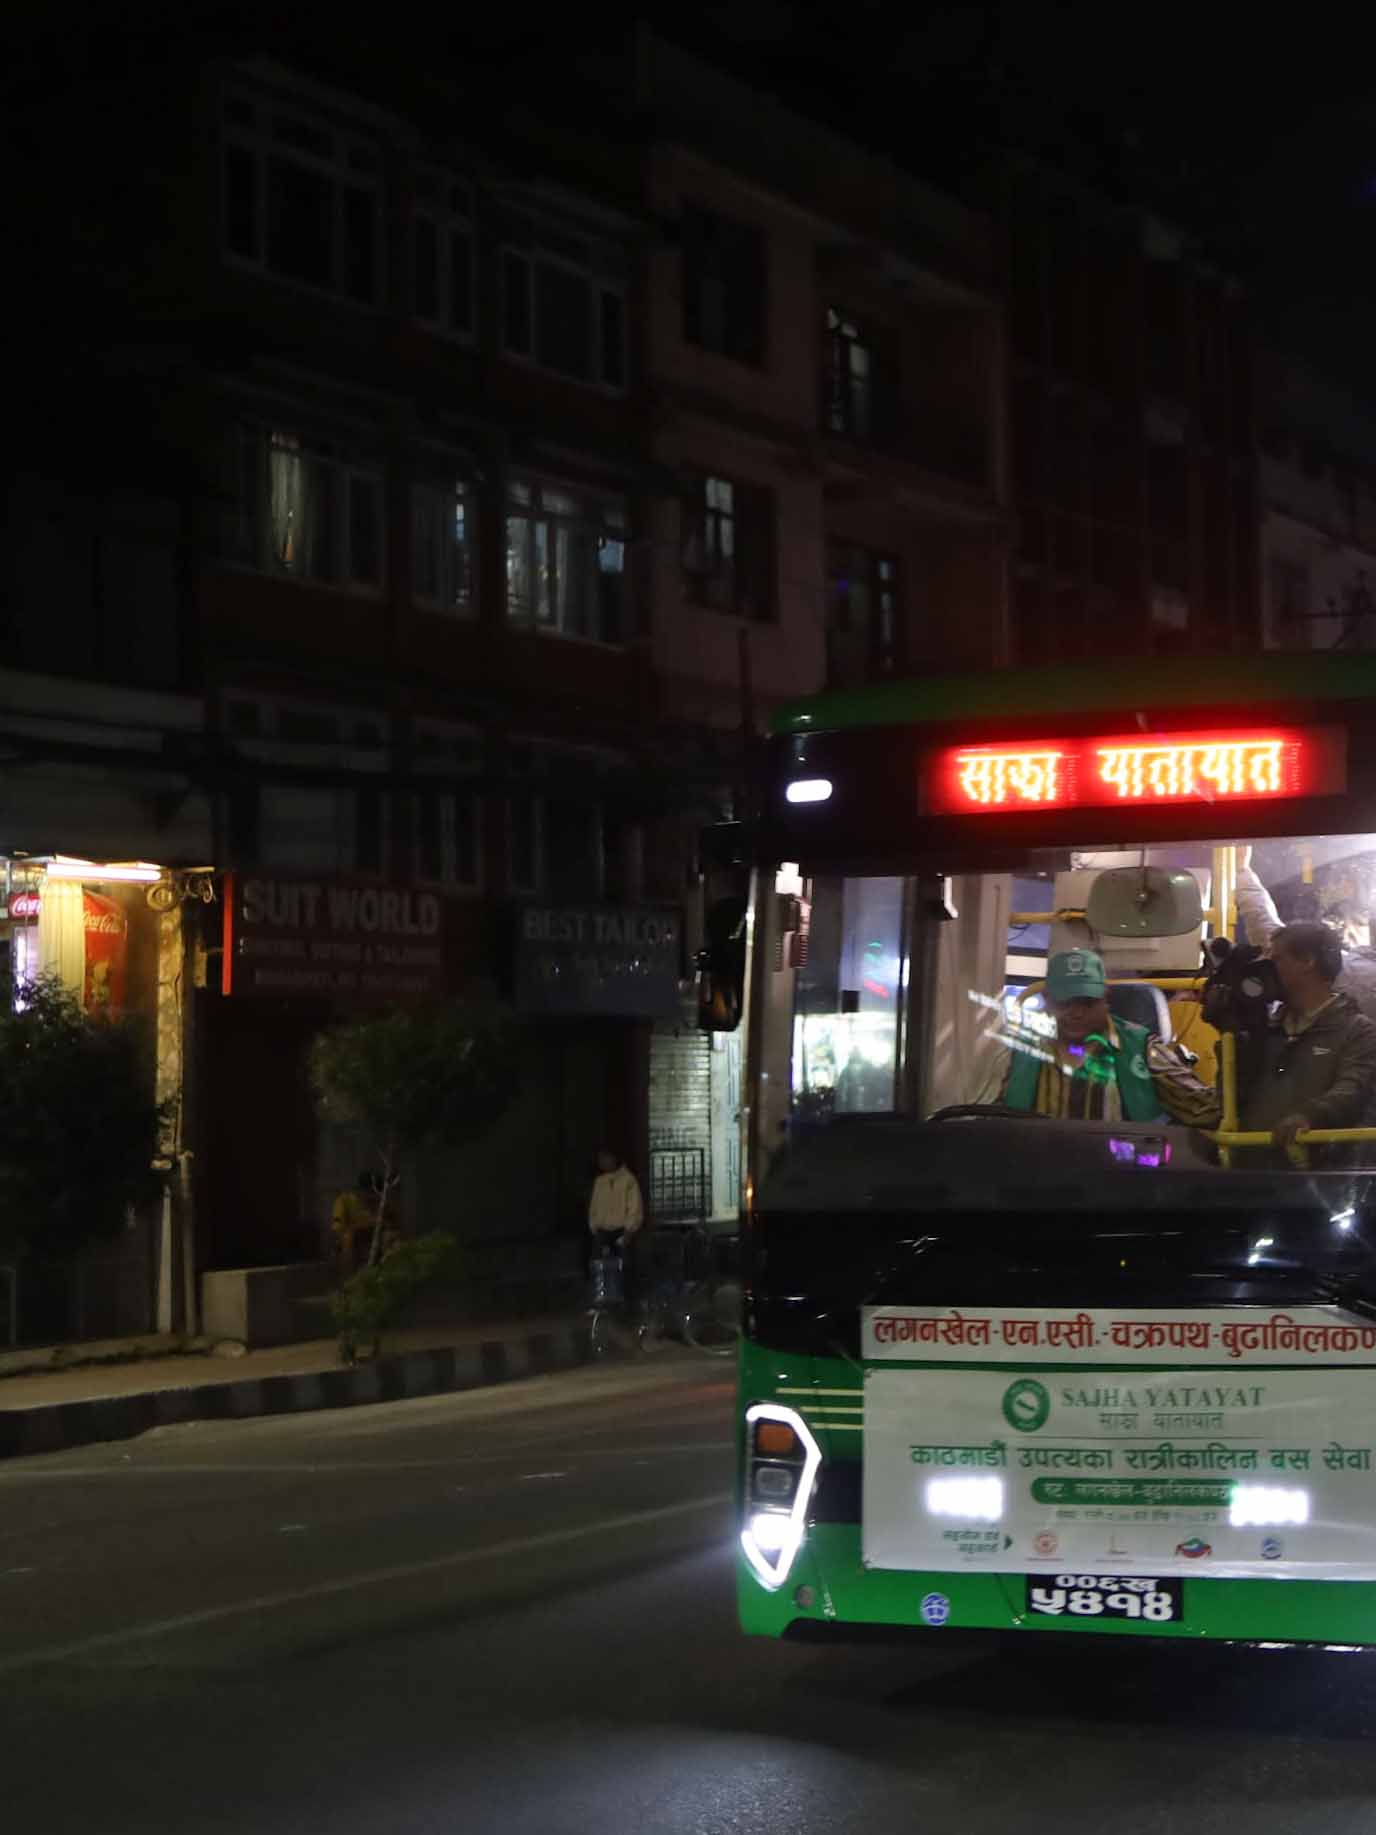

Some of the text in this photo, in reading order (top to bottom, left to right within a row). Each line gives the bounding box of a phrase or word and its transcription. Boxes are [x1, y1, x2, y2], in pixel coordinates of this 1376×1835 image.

[1097, 740, 1284, 798] यातायात
[243, 880, 441, 934] SUIT WORLD
[523, 907, 587, 940] BEST
[1061, 1387, 1137, 1408] SAJHA
[1148, 1387, 1265, 1407] YATAYAT
[1321, 1441, 1372, 1471] सेवा
[1031, 1587, 1174, 1621] ५४१४
